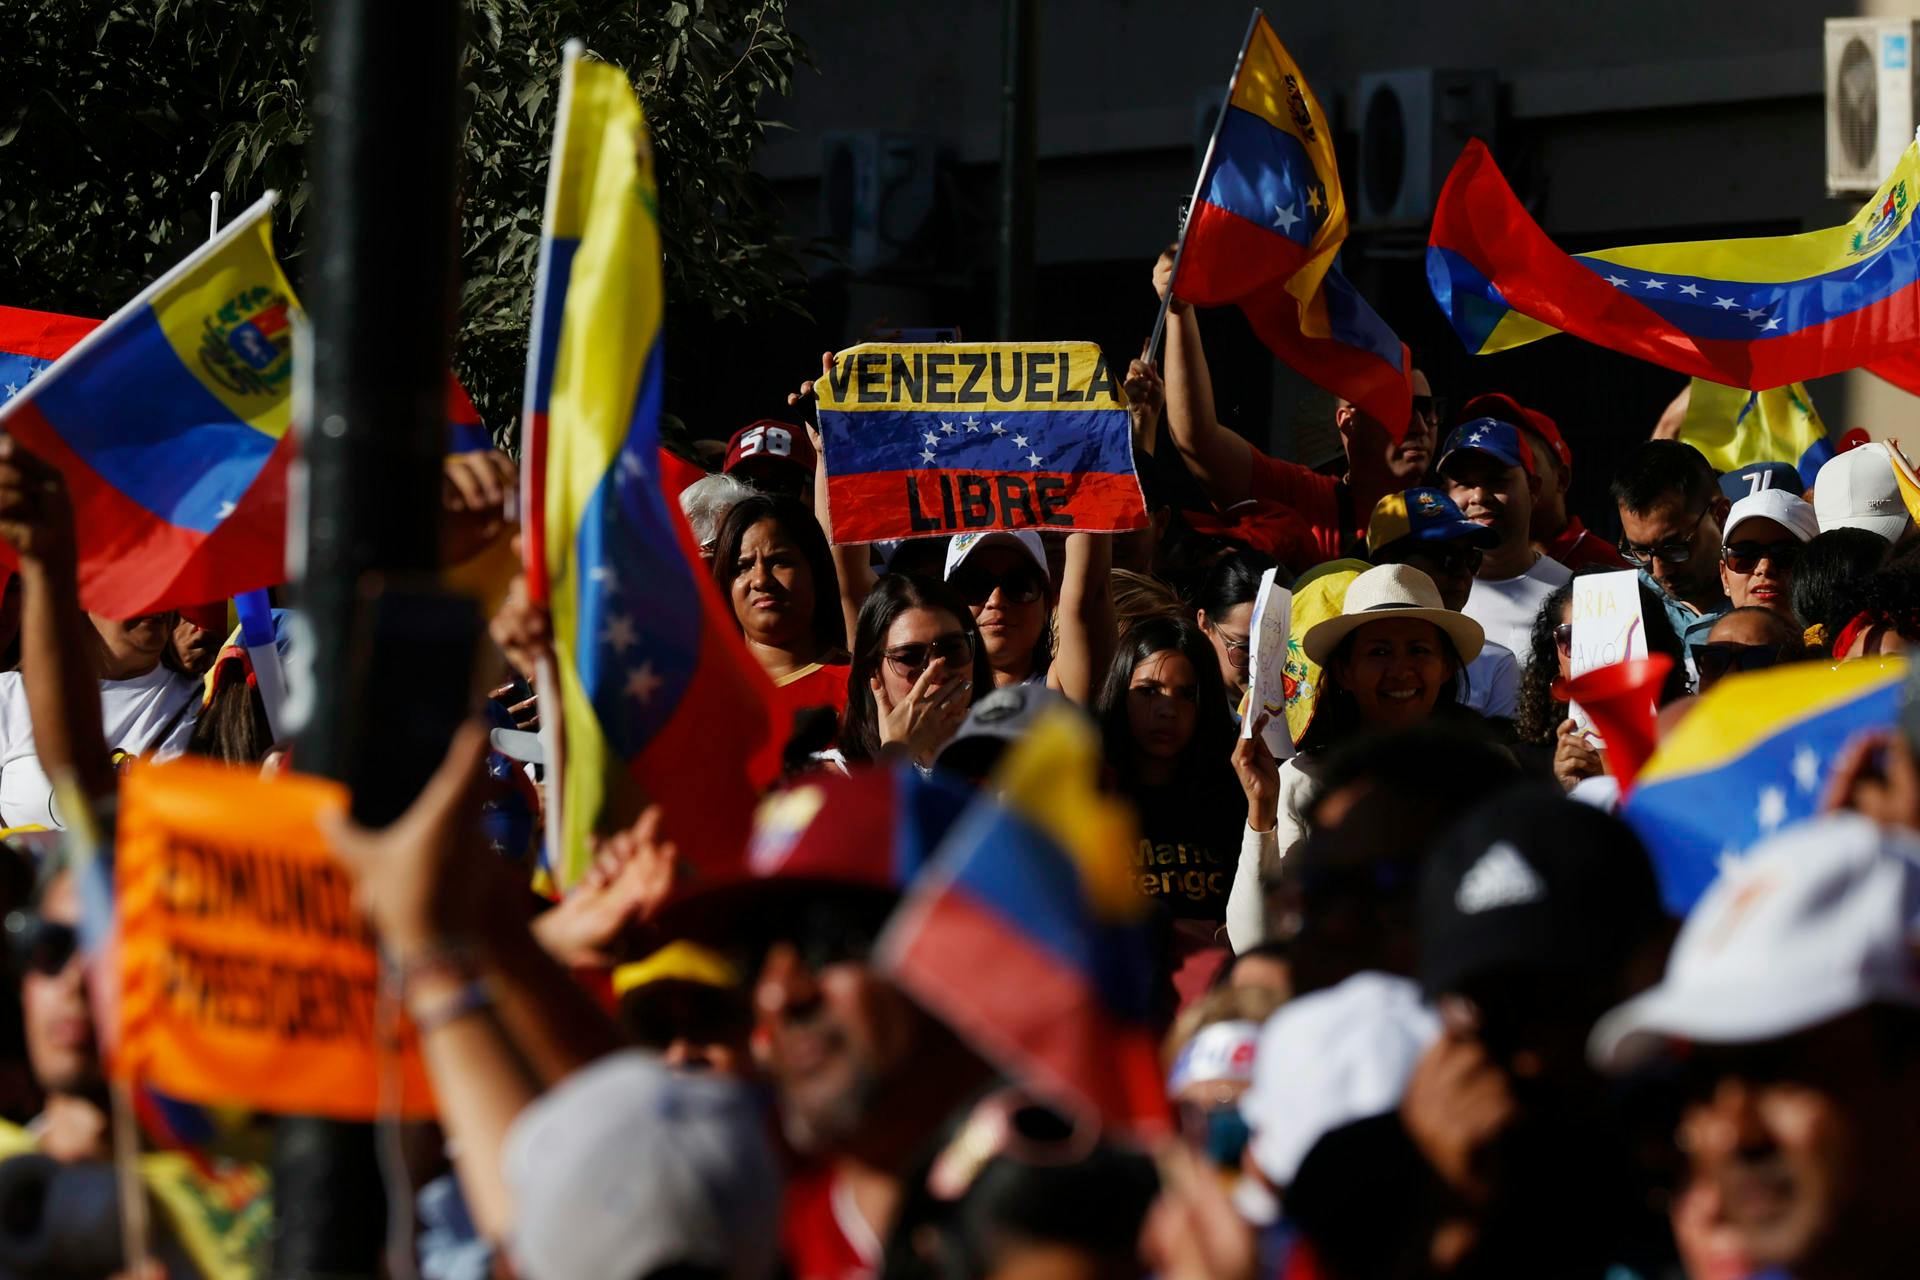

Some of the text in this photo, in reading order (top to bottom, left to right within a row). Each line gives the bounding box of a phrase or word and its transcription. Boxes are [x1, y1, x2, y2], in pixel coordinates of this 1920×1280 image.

[829, 352, 1119, 404] VENEZUELA
[740, 426, 792, 458] 58
[906, 474, 1075, 532] LIBRE
